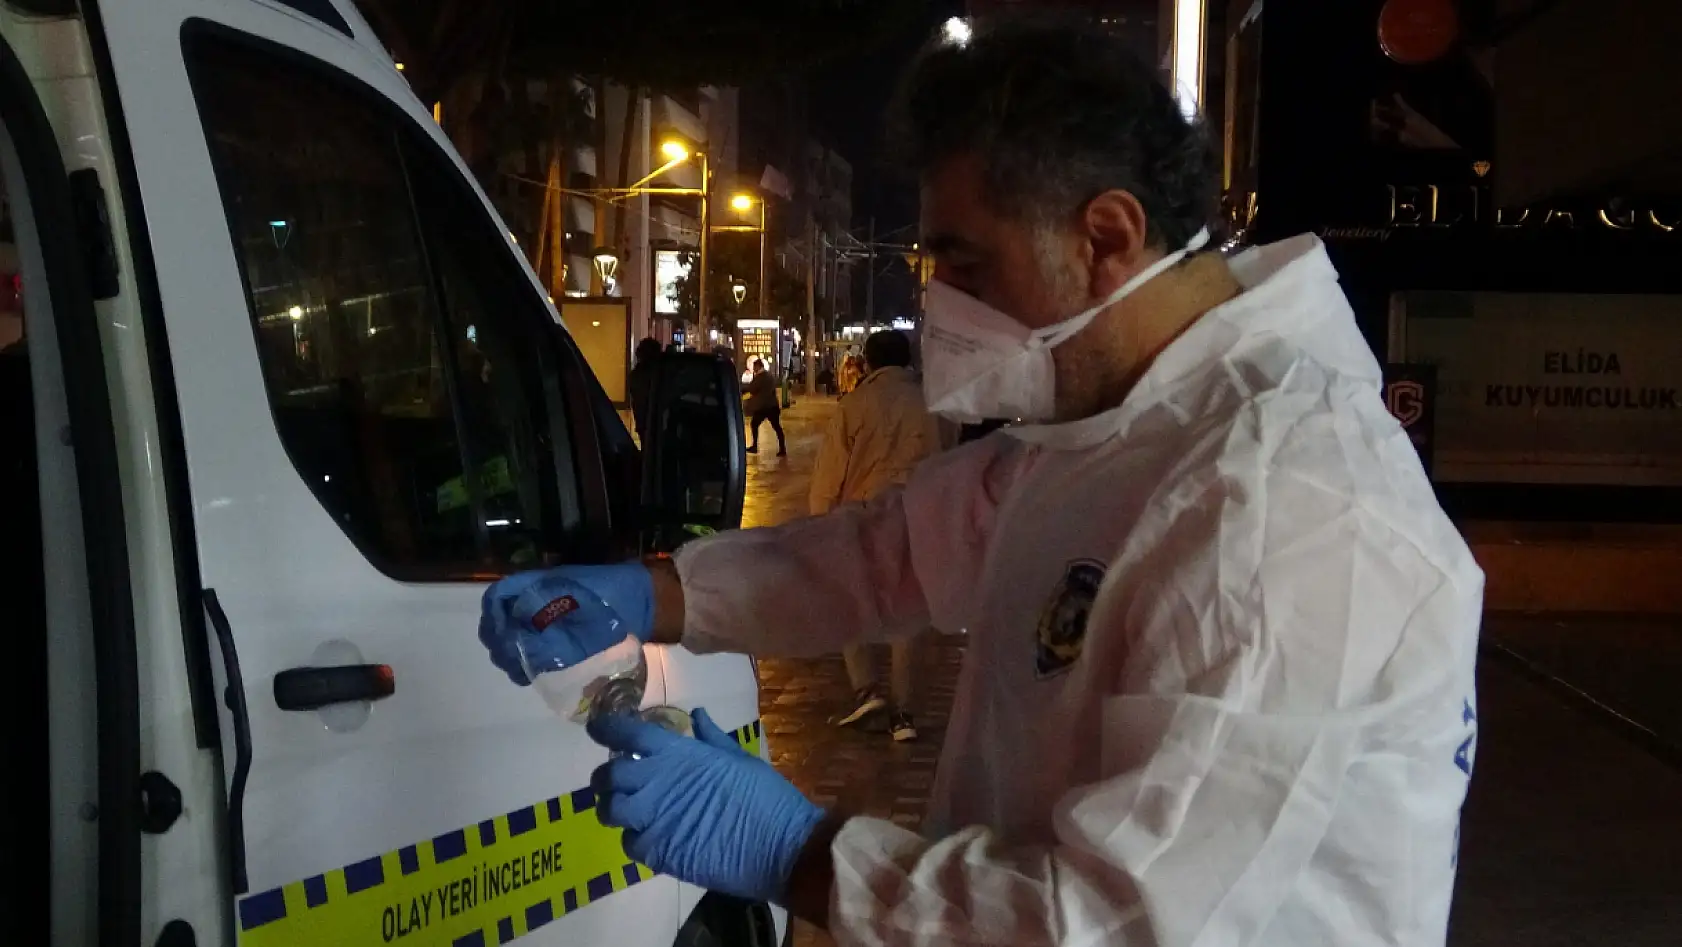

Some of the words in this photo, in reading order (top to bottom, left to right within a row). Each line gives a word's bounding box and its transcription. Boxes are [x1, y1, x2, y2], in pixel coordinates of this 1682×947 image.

[1544, 347, 1621, 374] ELİDA
[1485, 384, 1677, 409] KUYUMCULUK
[383, 891, 433, 943] OLAY
[438, 864, 478, 920] YERİ
[483, 842, 562, 903] İNCELEME
